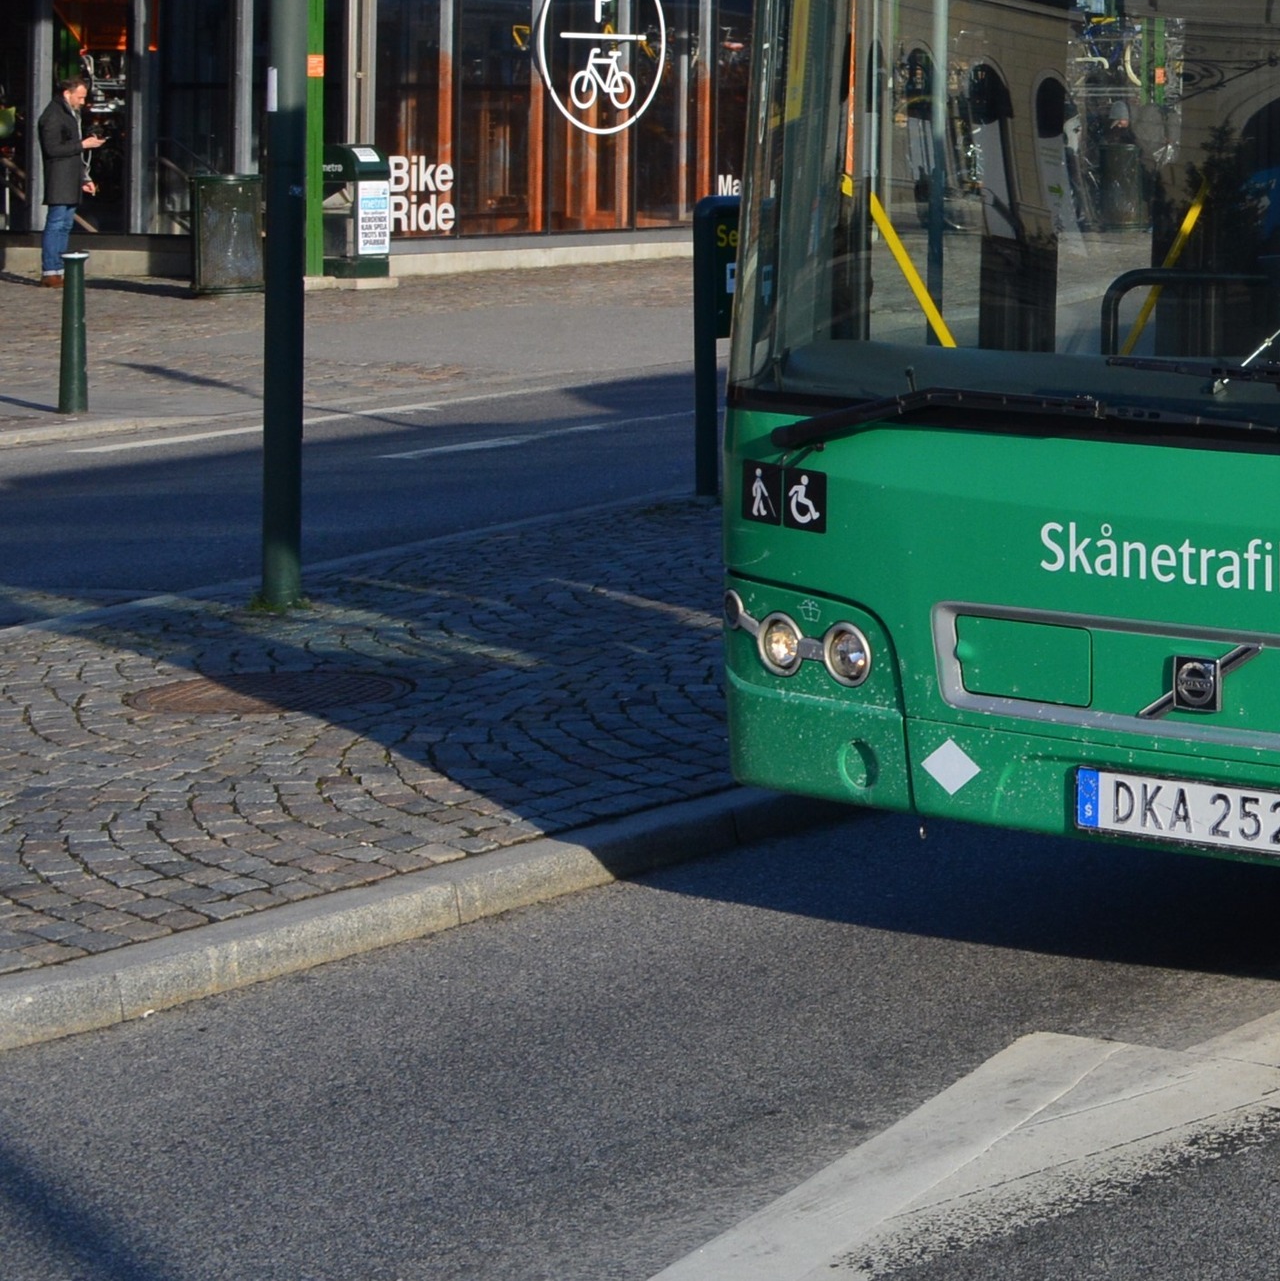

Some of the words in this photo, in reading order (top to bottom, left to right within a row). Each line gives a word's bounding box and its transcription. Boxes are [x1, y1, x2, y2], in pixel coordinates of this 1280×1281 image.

[388, 155, 454, 192] Bike
[389, 194, 455, 232] Ride
[1113, 778, 1193, 834] DKA
